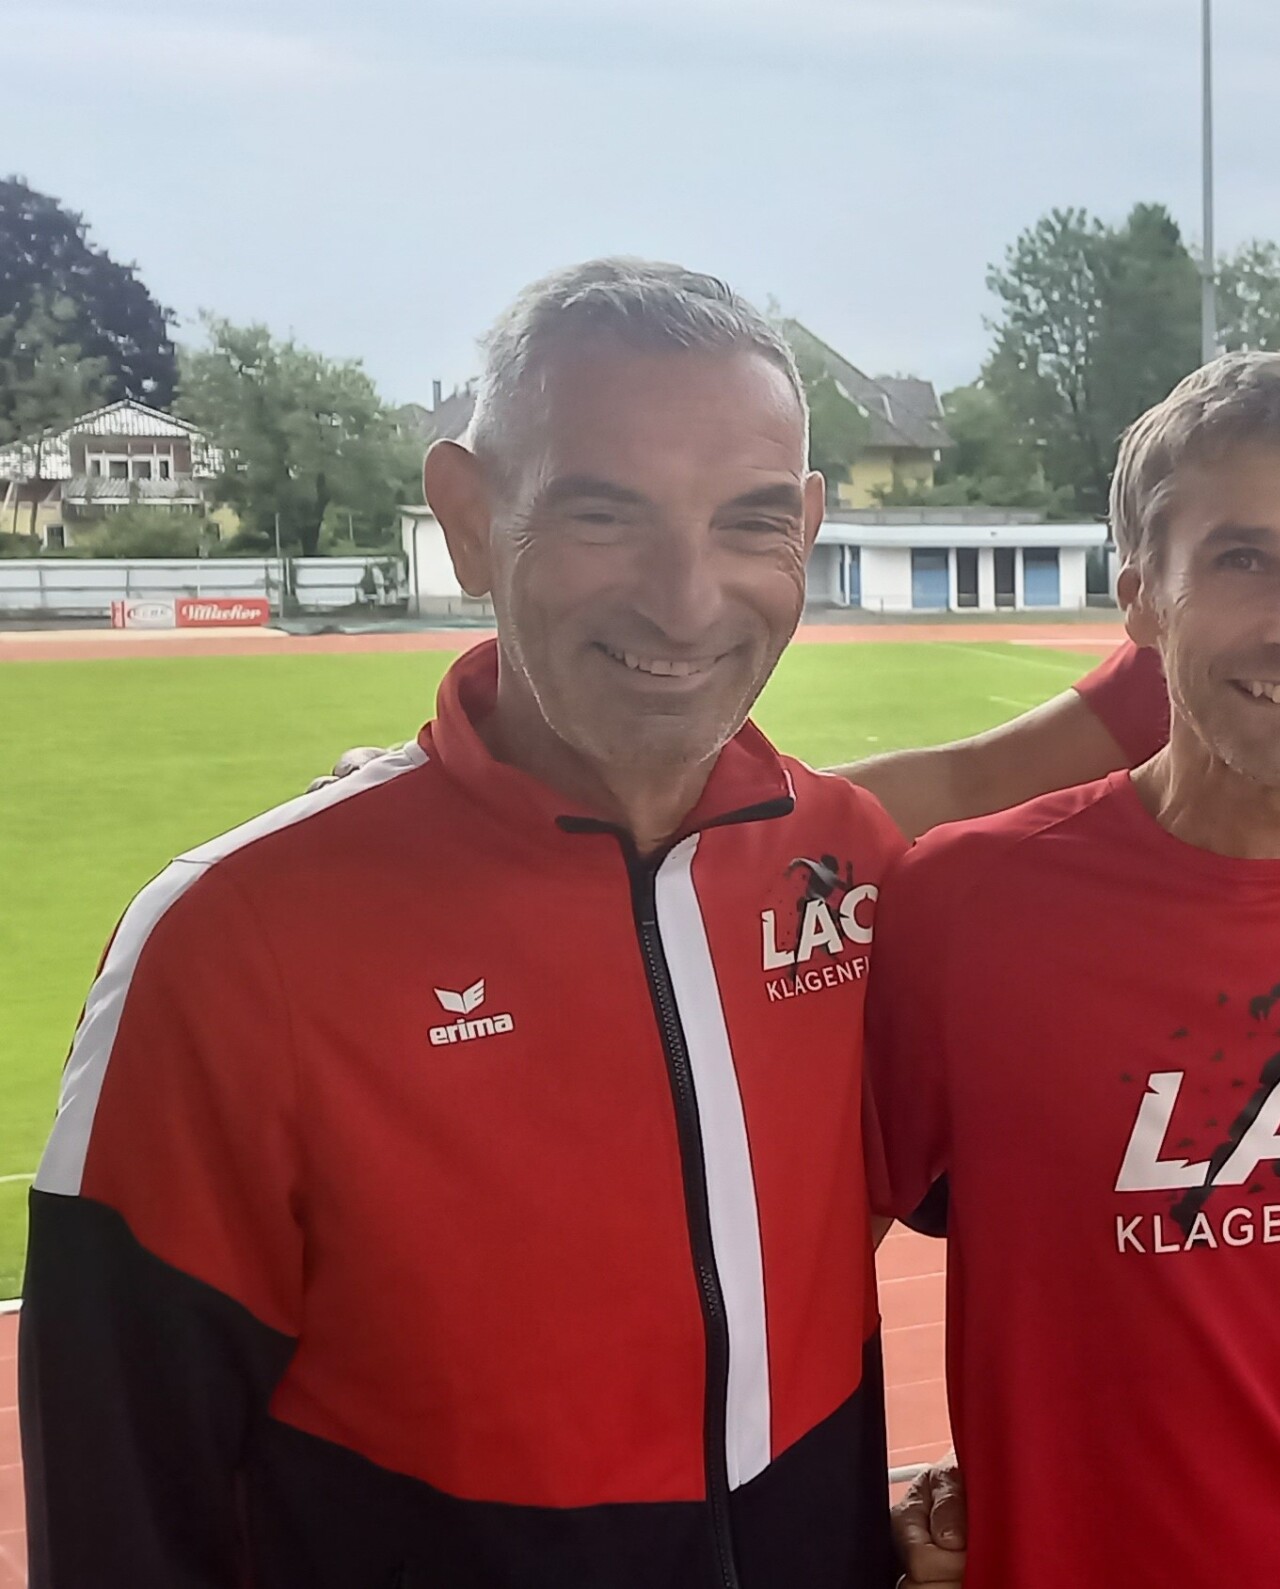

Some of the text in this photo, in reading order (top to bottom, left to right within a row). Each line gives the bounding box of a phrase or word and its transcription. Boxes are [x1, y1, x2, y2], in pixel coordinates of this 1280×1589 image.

[761, 884, 879, 971] LAC
[766, 956, 870, 1002] KLAGENF
[429, 1013, 514, 1046] erima
